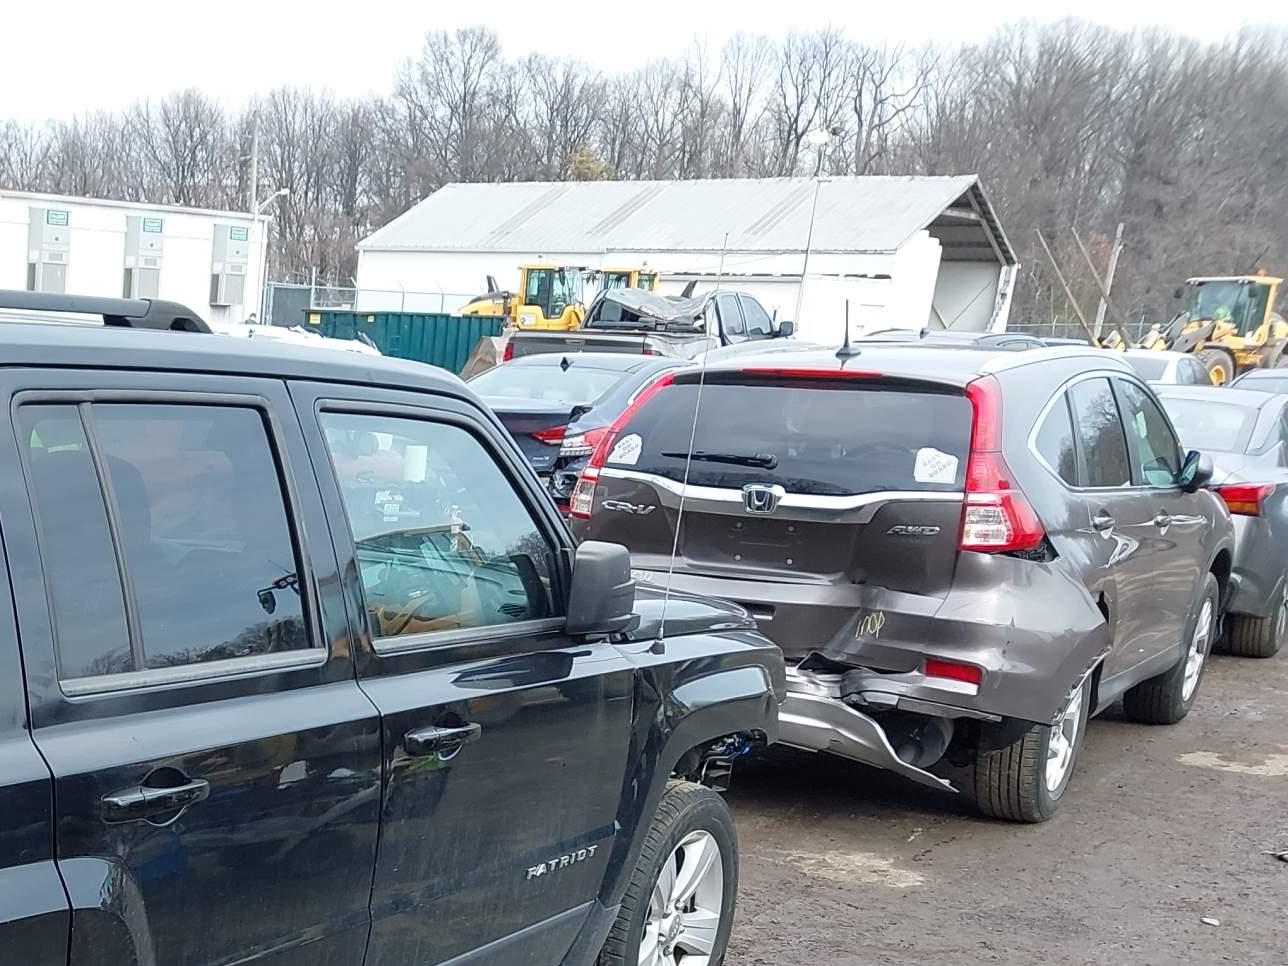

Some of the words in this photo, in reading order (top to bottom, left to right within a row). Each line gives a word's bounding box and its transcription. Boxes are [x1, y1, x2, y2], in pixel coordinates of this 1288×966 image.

[602, 500, 656, 514] CR-V
[887, 525, 941, 535] AWD
[526, 844, 598, 880] PATRIOT
